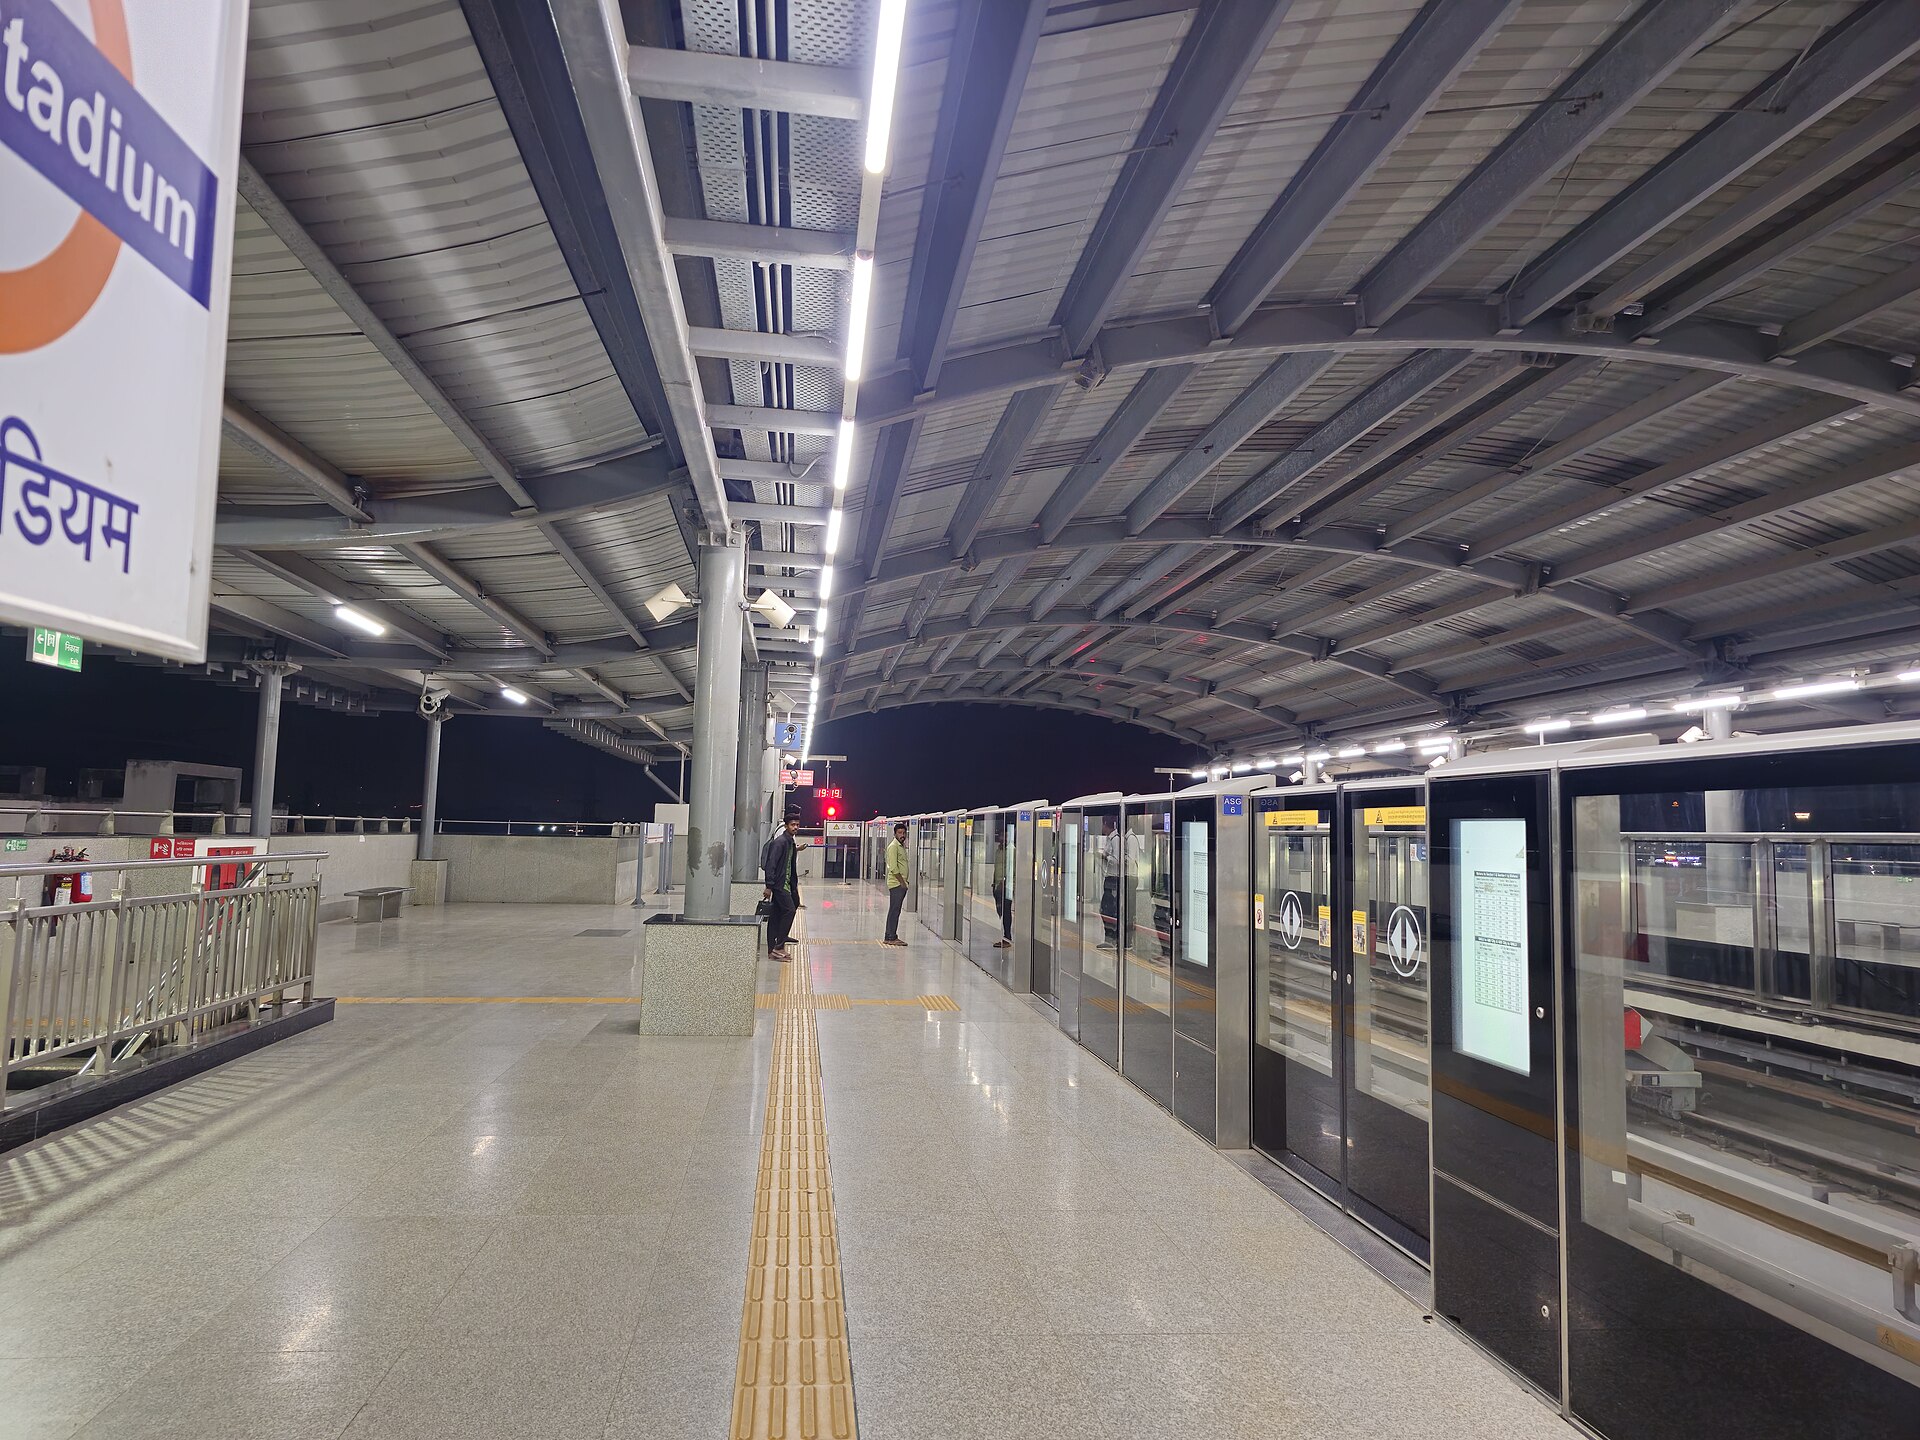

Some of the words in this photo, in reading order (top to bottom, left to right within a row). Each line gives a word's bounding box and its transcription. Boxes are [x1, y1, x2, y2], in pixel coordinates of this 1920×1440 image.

[0, 17, 194, 261] tadium
[0, 415, 139, 574] डियम
[1230, 806, 1236, 814] 6
